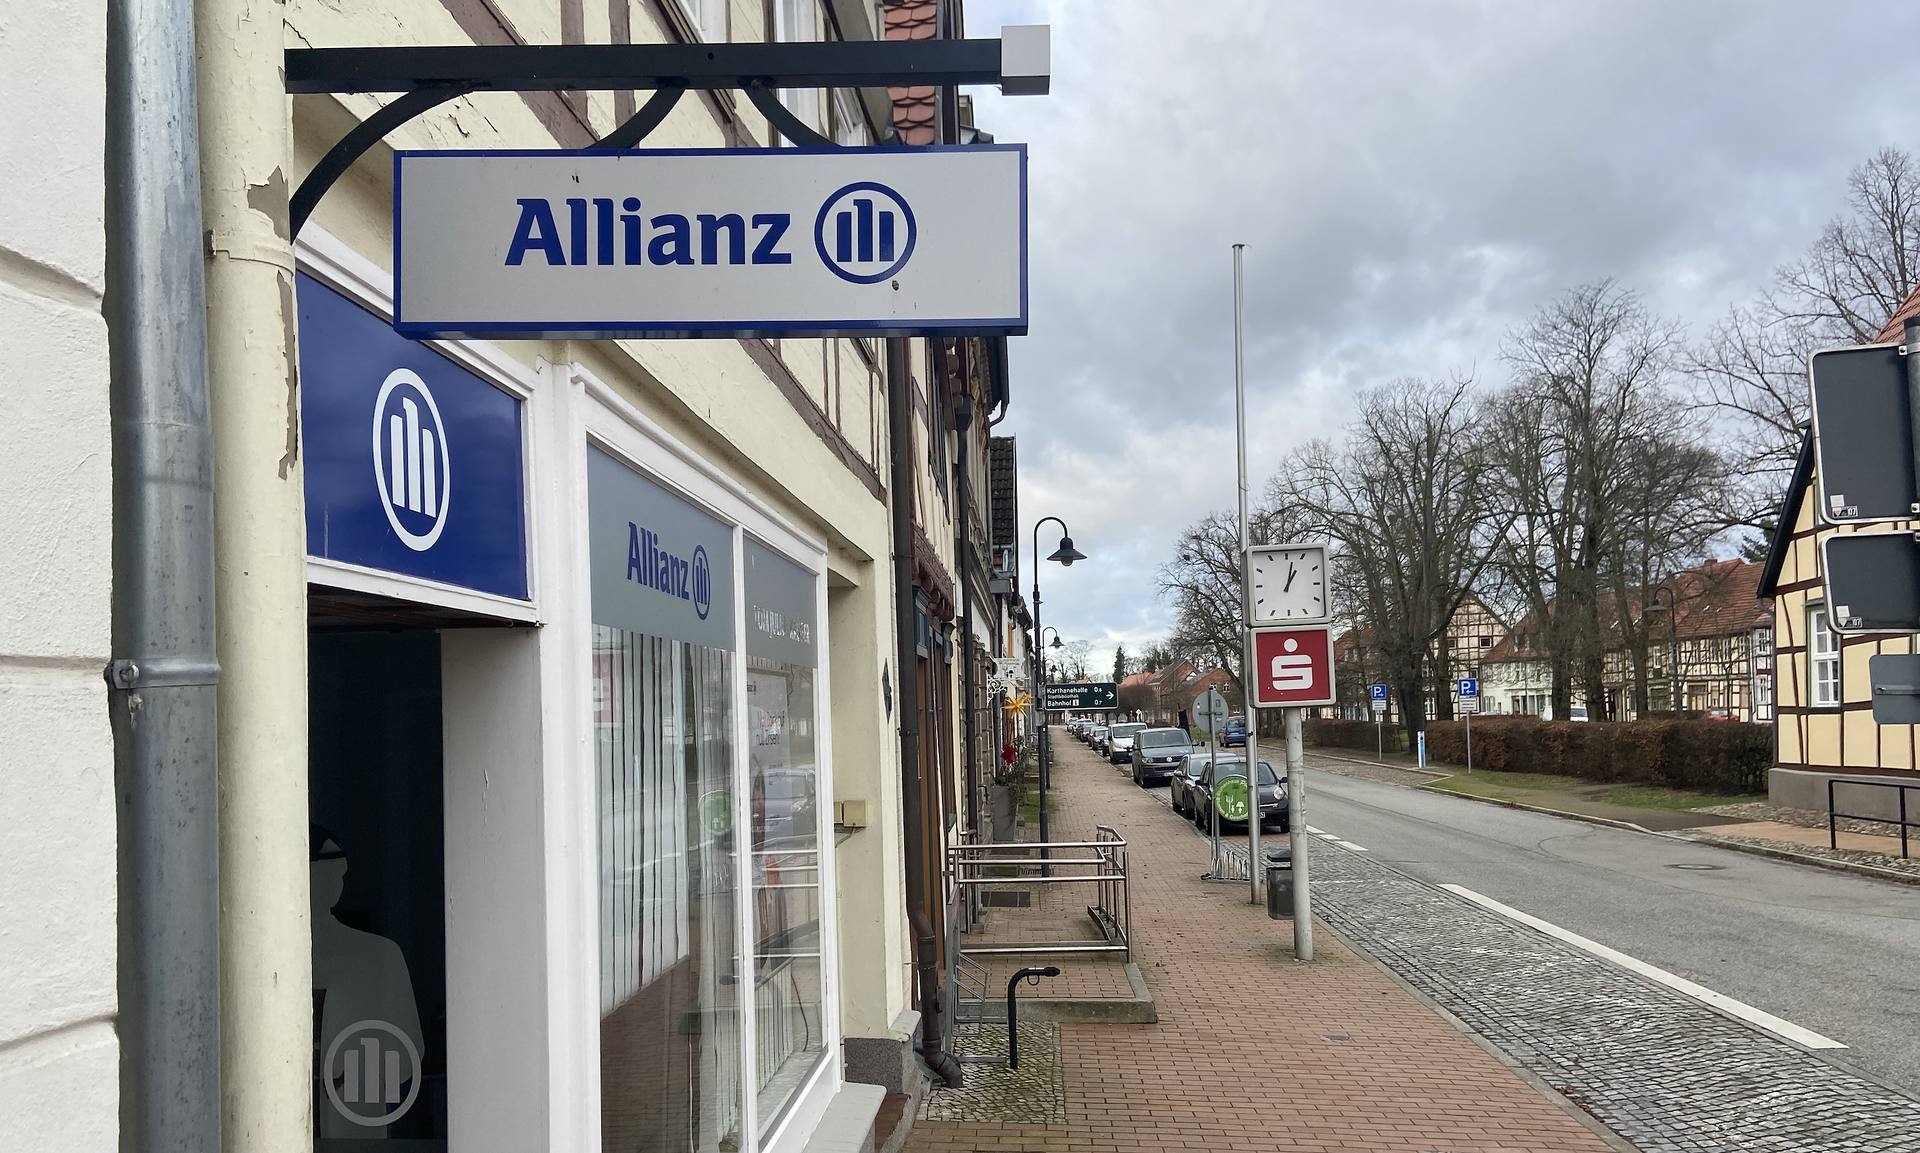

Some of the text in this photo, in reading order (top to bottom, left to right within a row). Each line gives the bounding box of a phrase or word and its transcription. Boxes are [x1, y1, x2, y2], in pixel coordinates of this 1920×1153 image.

[504, 196, 792, 267] Allianz
[626, 521, 690, 601] Allianz
[1373, 686, 1382, 697] P
[1461, 681, 1471, 695] P
